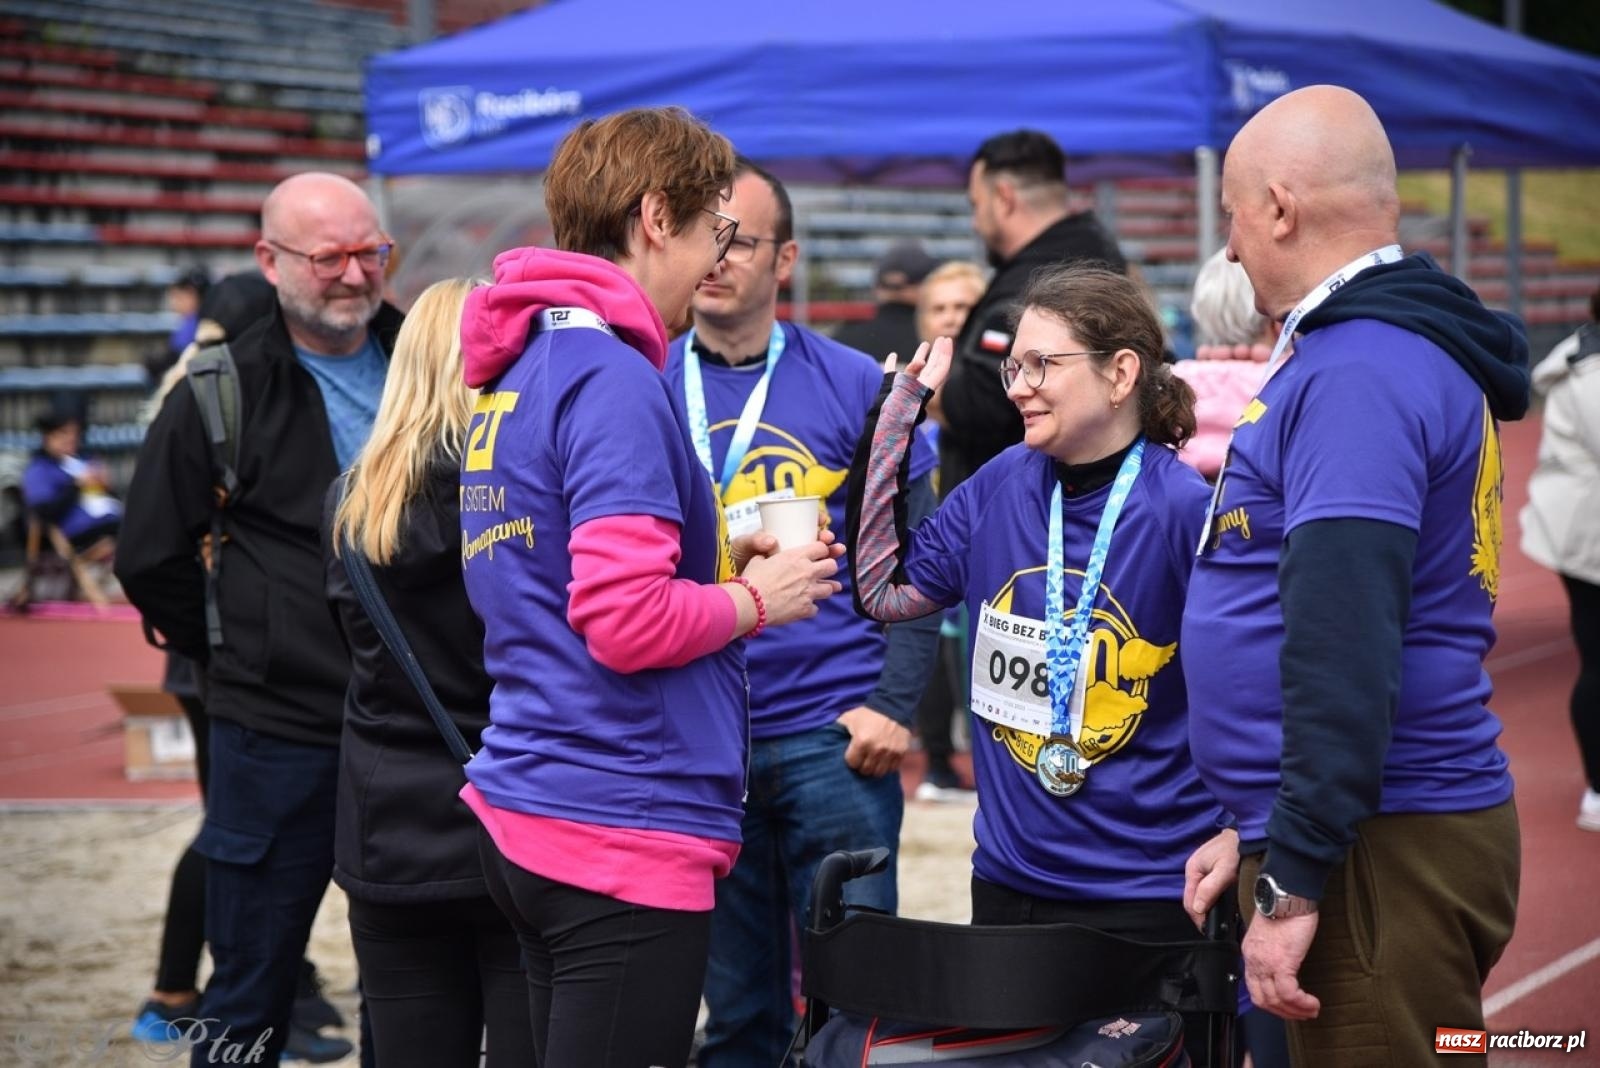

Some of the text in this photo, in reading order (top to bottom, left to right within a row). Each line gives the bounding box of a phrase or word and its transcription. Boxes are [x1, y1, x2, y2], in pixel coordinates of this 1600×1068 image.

[989, 615, 1009, 632] BIEG
[1012, 623, 1036, 639] BEZ
[989, 649, 1051, 698] 098
